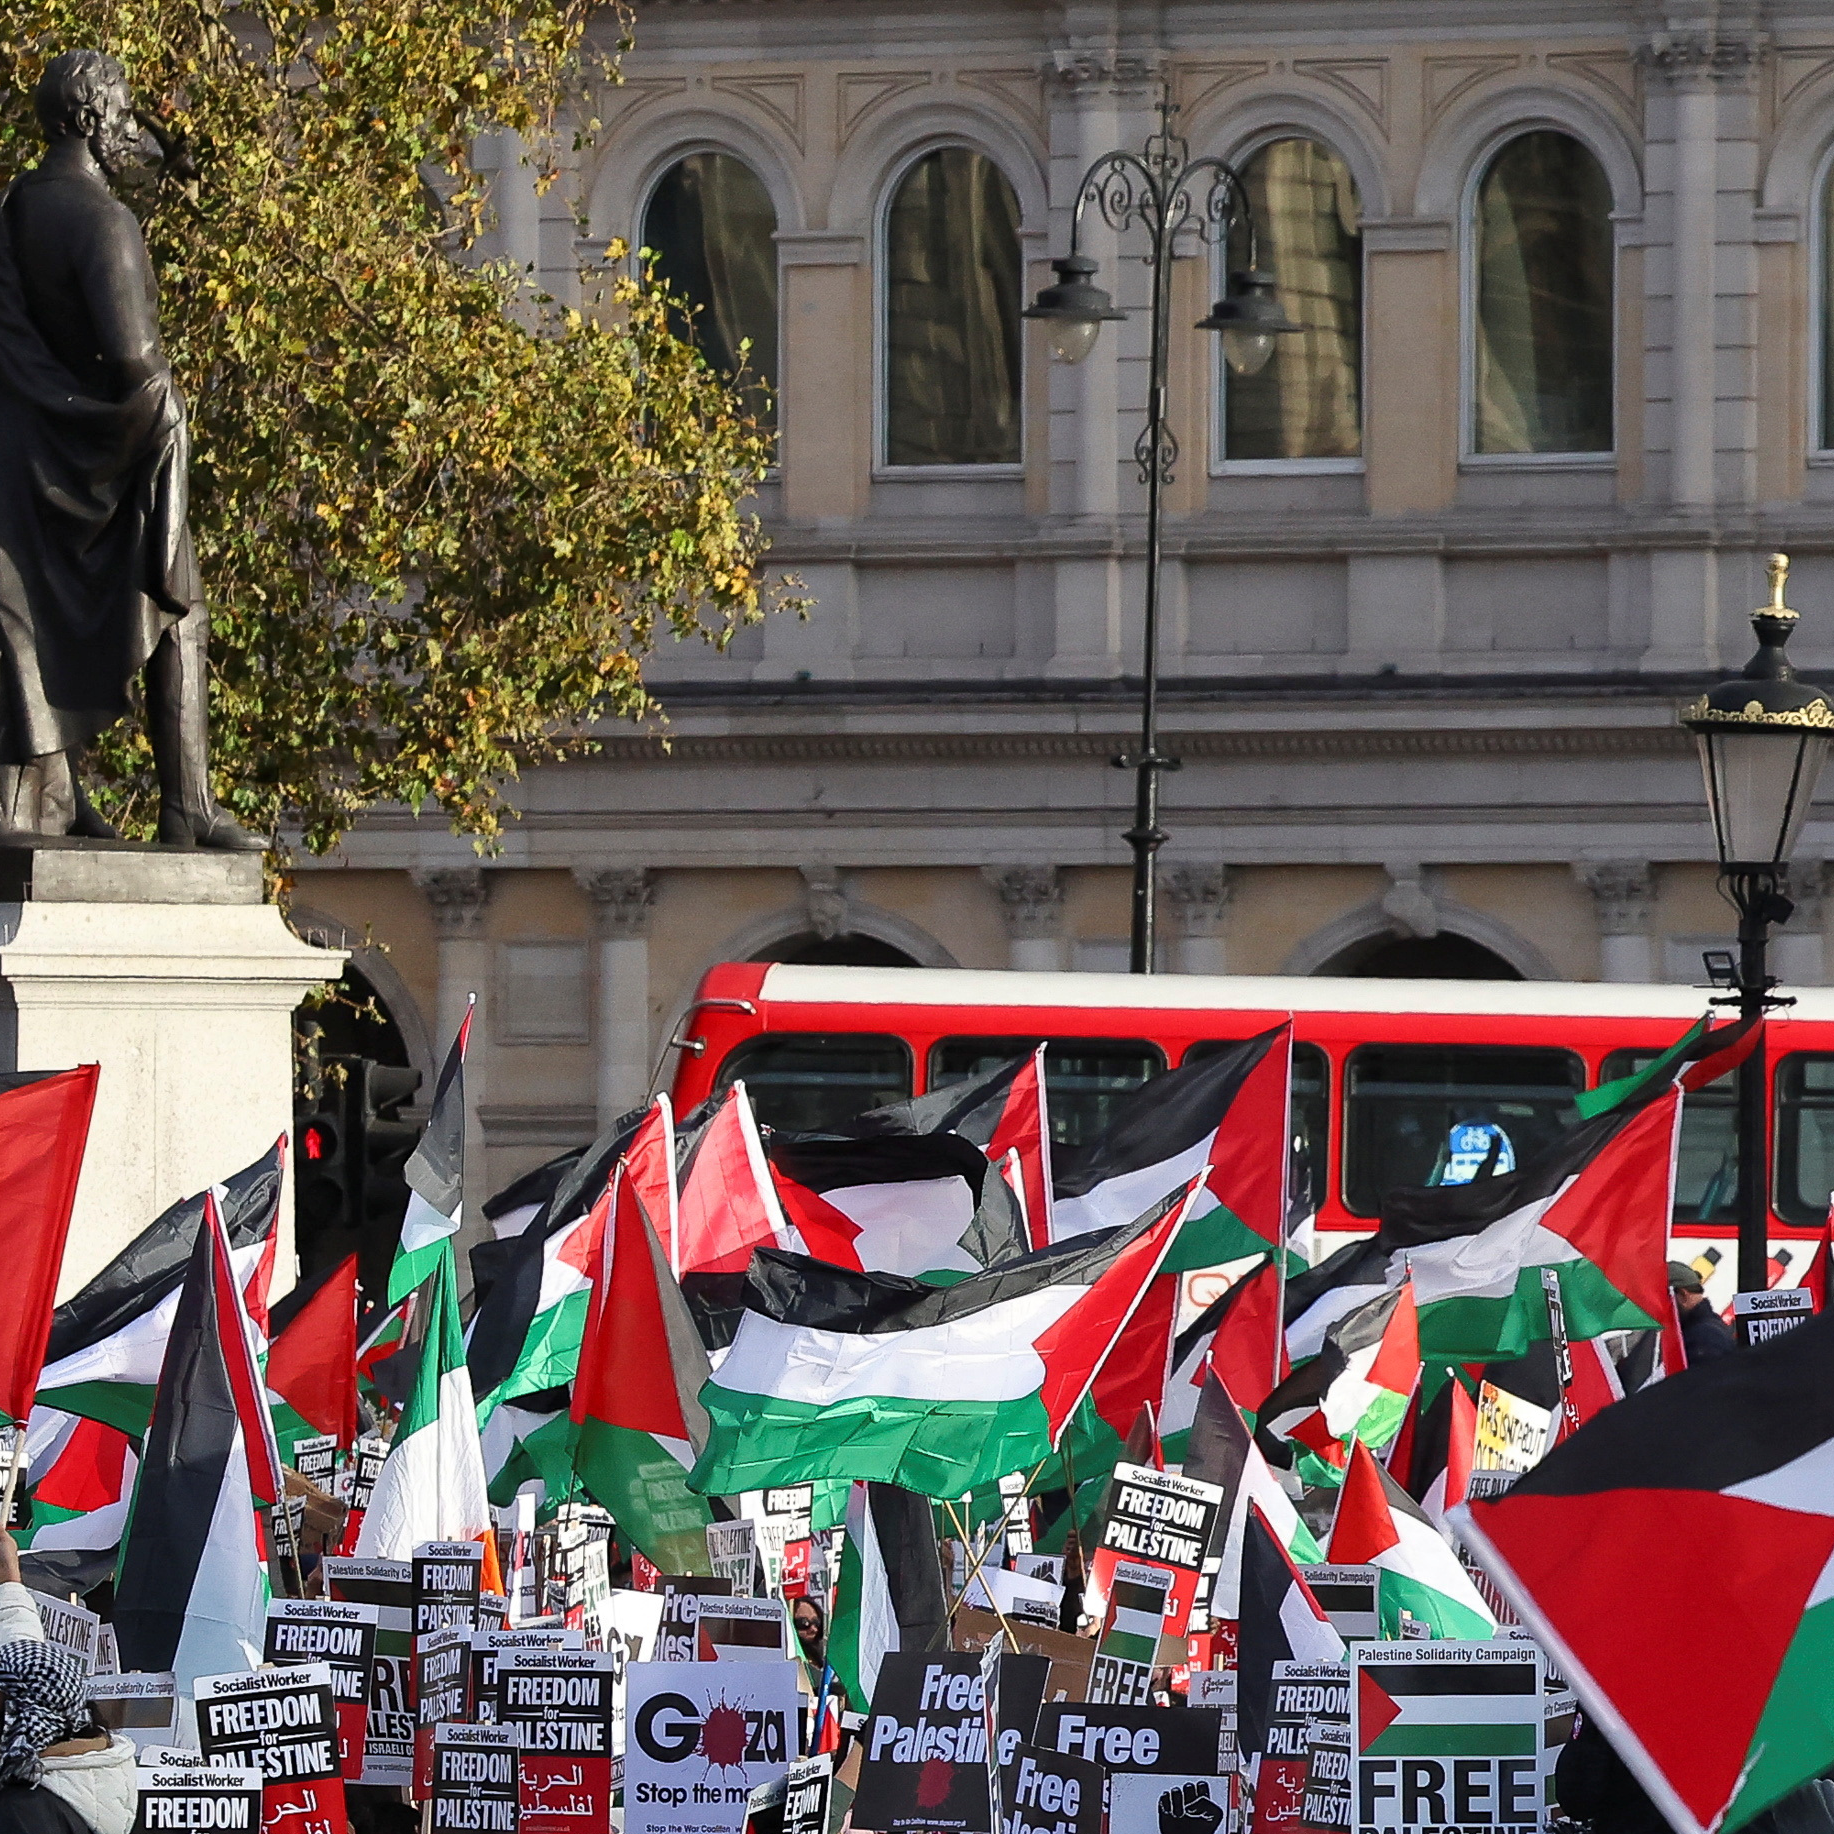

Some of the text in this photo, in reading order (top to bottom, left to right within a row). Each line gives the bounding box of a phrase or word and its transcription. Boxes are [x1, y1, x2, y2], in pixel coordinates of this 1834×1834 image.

[1131, 1470, 1205, 1497] Socialist Worker
[1117, 1485, 1207, 1530] FREEDOM
[1104, 1522, 1203, 1568] PALESTINE
[328, 1564, 400, 1580] Palestine Solidarity
[1304, 1570, 1375, 1584] Solidarity Campaign
[285, 1604, 360, 1619] Socialist Worker
[753, 1606, 782, 1620] Campaign
[40, 1605, 94, 1653] PALESTINE
[275, 1623, 363, 1656] FREEDOM
[514, 1655, 596, 1669] Socialist Worker
[1357, 1647, 1536, 1664] Palestine Solidarity Campaign
[212, 1671, 311, 1694] Socialist Worker
[1093, 1655, 1150, 1706] FREE
[1284, 1665, 1318, 1678] Socialist
[507, 1677, 599, 1708] FREEDOM
[919, 1664, 984, 1712] Free
[1275, 1686, 1350, 1714] FREEDOM
[209, 1694, 322, 1736] FREEDOM
[870, 1715, 1021, 1767] Palestine
[1058, 1714, 1160, 1766] Free
[152, 1773, 245, 1788] Socialist Worker
[440, 1751, 512, 1785] FREEDOM
[636, 1782, 722, 1808] Stop the
[1016, 1759, 1080, 1817] Free
[1358, 1759, 1538, 1825] FREE
[145, 1797, 249, 1829] FREEDOM
[436, 1797, 515, 1832] PALESTINE
[646, 1824, 667, 1834] Stop
[669, 1824, 680, 1833] the
[682, 1824, 696, 1833] War
